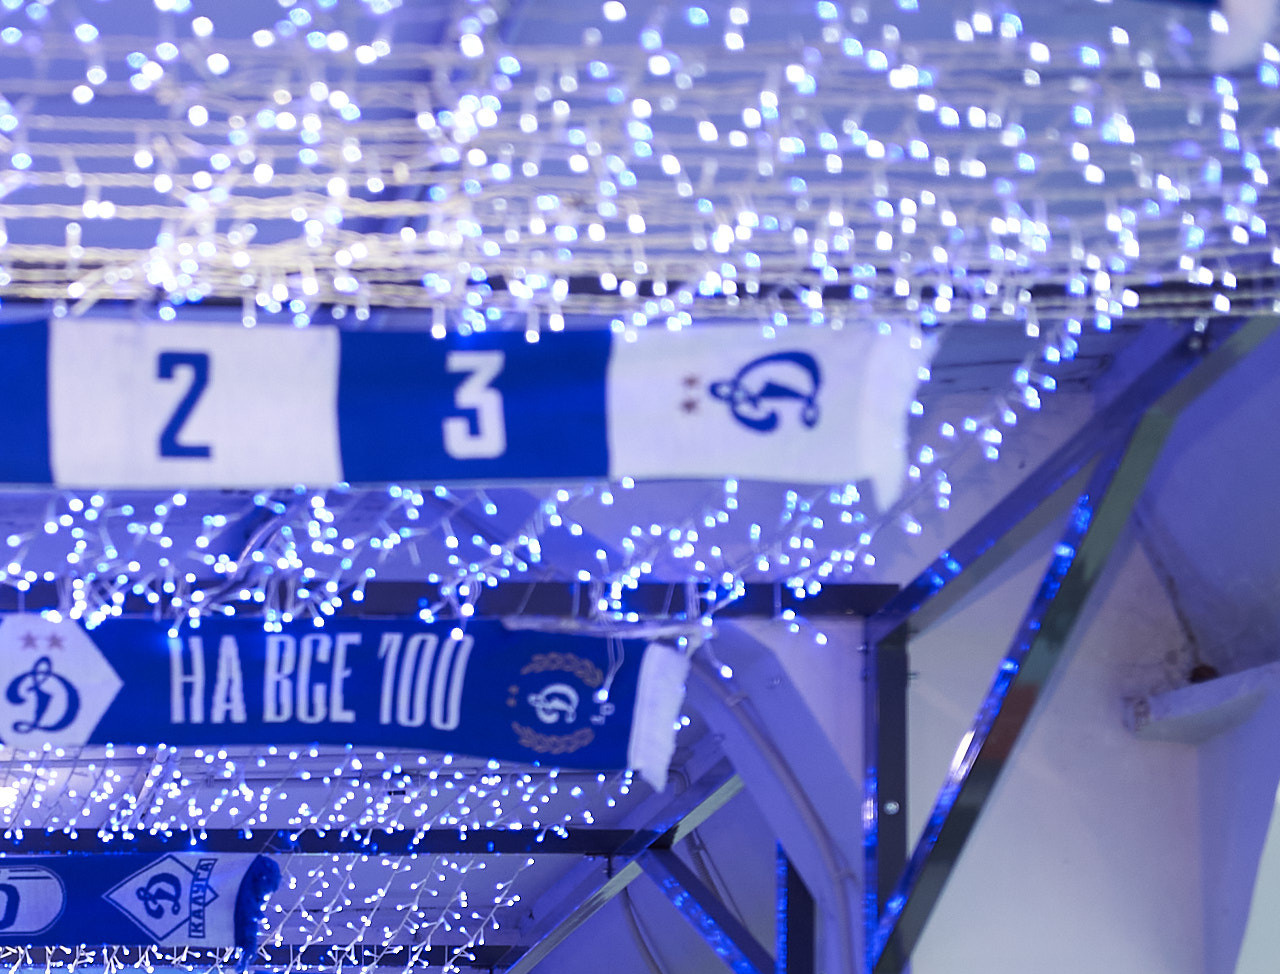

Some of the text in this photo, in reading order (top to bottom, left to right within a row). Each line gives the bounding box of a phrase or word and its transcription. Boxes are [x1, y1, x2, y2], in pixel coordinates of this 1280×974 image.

[157, 351, 212, 459] 2
[442, 350, 508, 460] 3
[169, 632, 475, 732] НА ВСЕ 100
[190, 859, 215, 937] КАЛУГА
